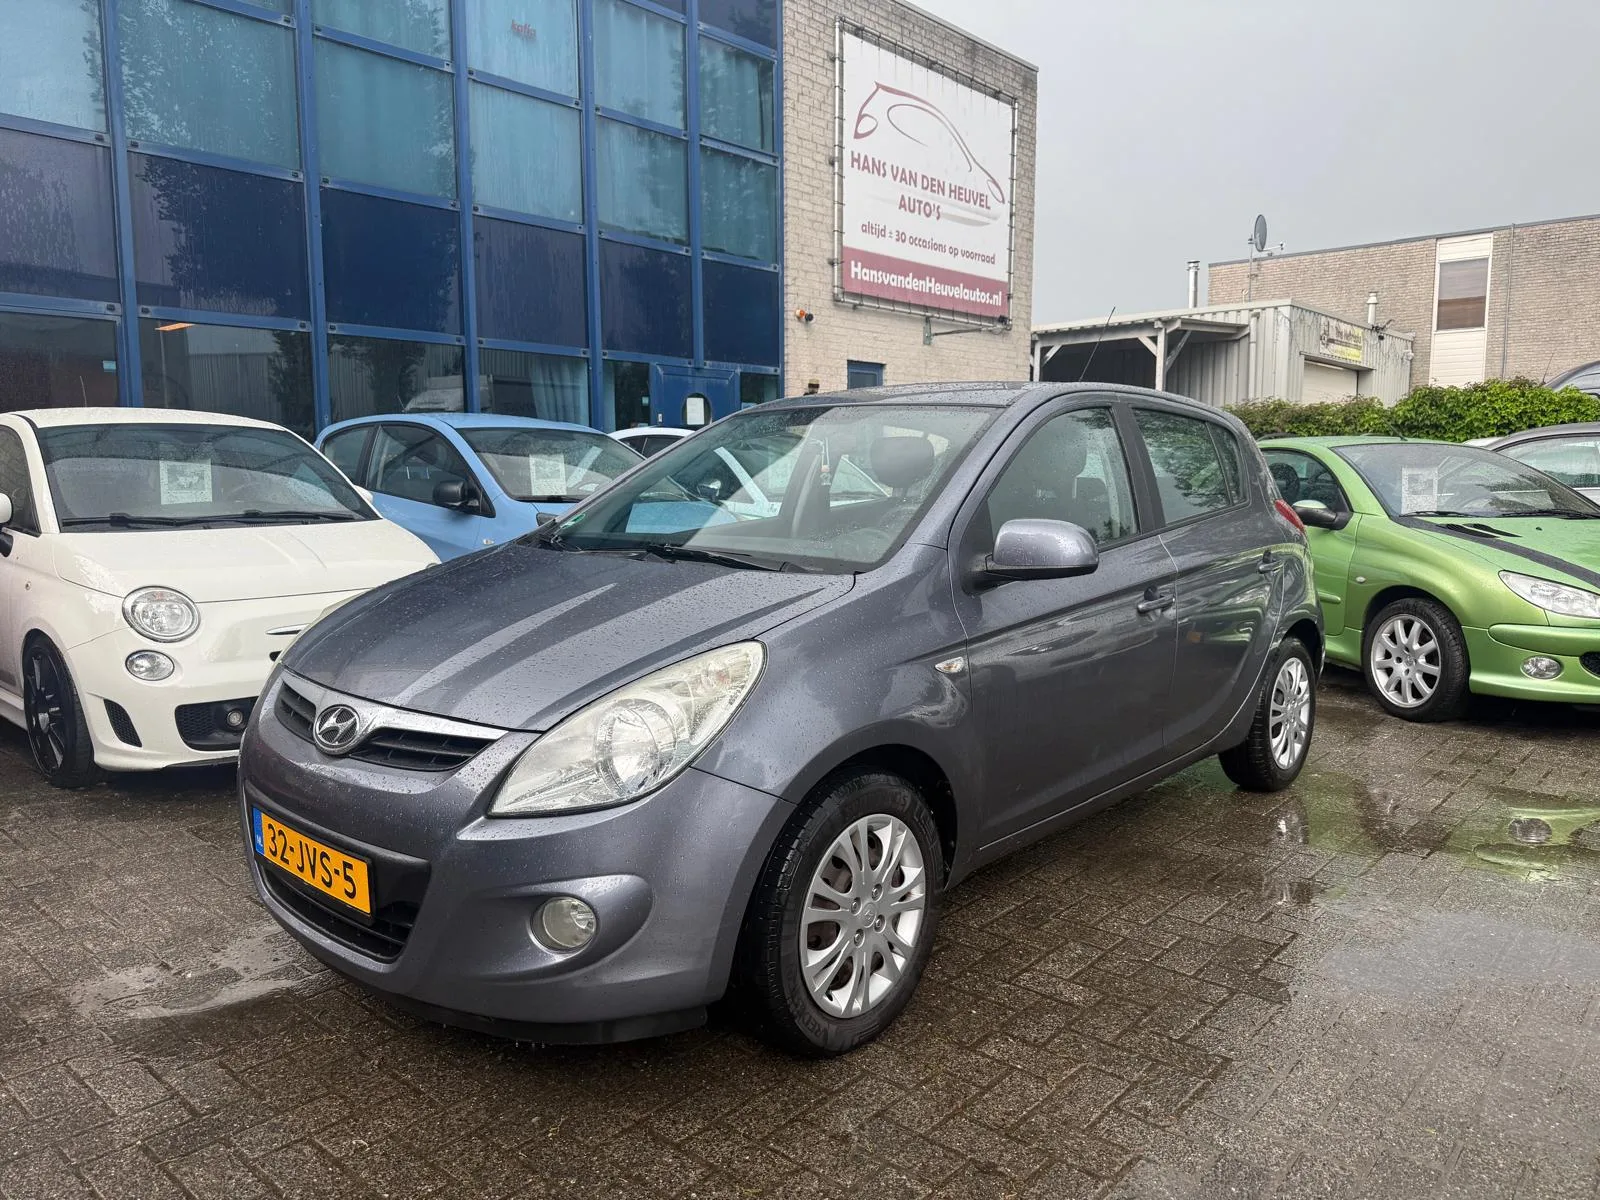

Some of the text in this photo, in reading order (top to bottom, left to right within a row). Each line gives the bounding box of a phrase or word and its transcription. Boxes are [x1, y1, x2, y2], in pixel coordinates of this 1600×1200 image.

[850, 150, 991, 210] HANS VAN DEN HEUVEL
[898, 194, 941, 221] AUTO'S
[861, 221, 887, 239] altijd
[895, 230, 907, 243] 30
[908, 235, 947, 254] occasions
[948, 246, 959, 258] op
[960, 248, 996, 265] voorraad
[850, 260, 1003, 306] HansvandenHeuvelautos.nl
[267, 823, 357, 899] 32-JVS-5
